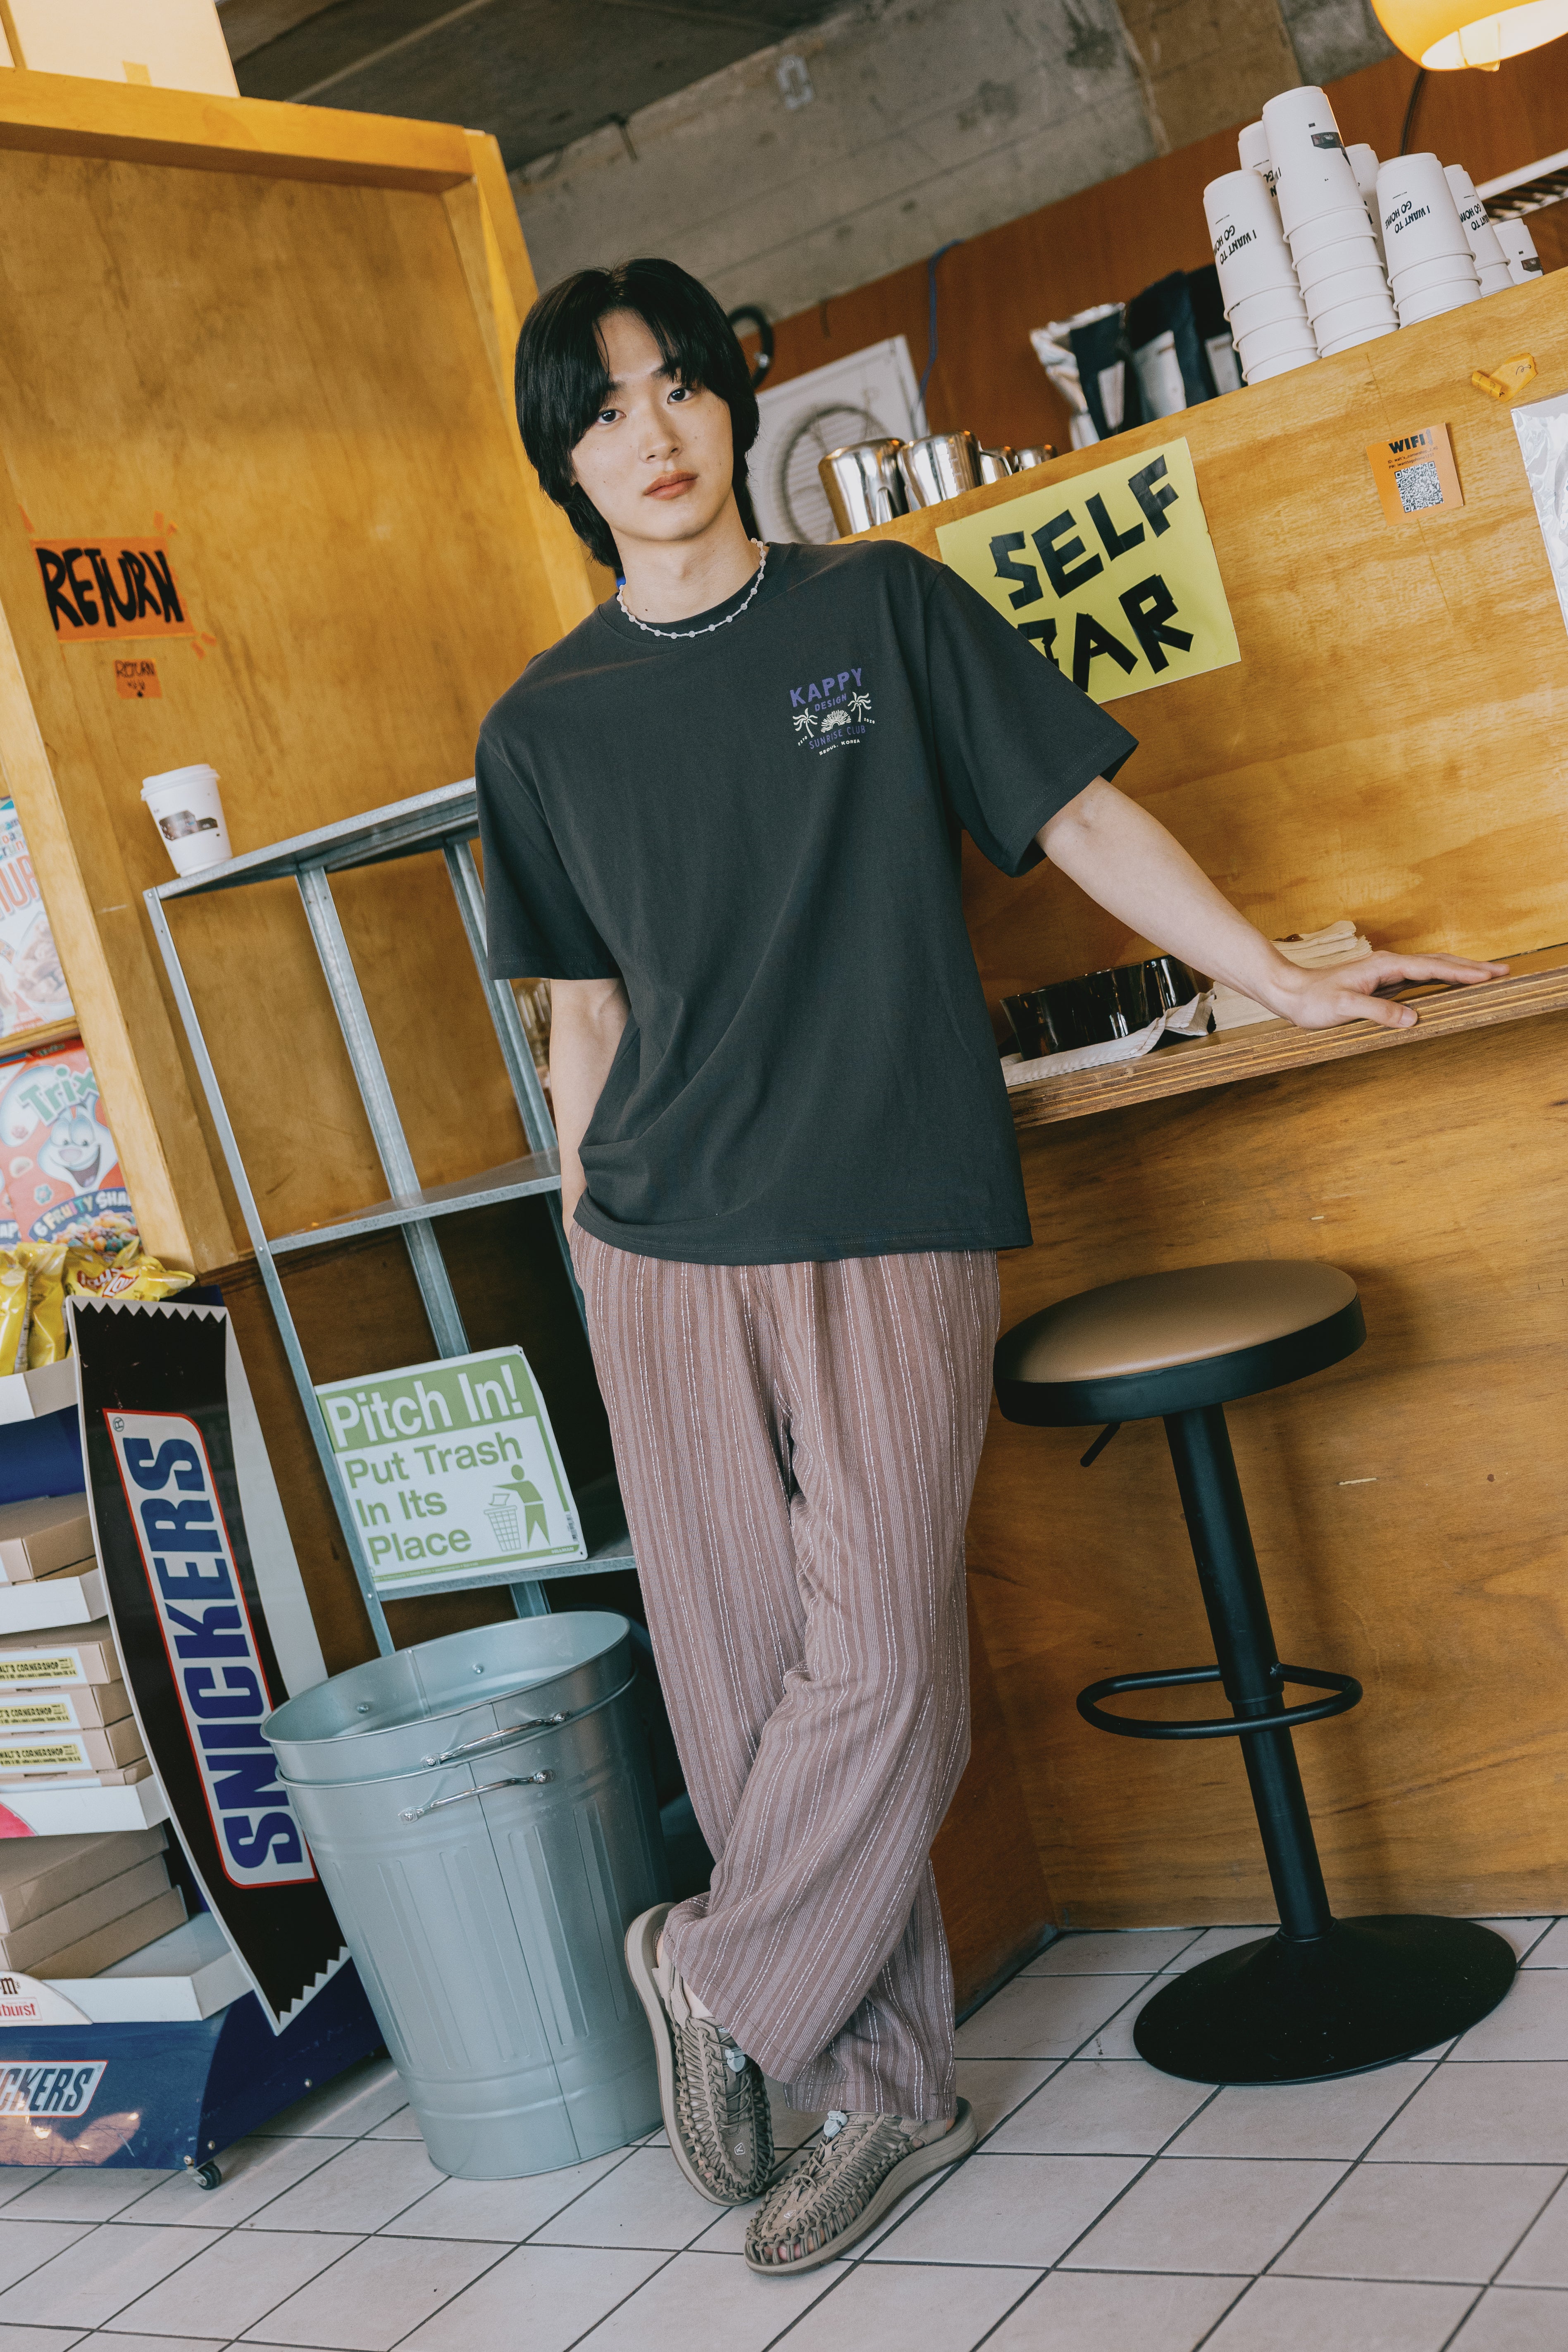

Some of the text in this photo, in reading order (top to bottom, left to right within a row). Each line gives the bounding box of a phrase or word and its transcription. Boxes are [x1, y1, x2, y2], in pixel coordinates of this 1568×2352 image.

[1385, 200, 1412, 230] GO HOME
[1395, 221, 1404, 234] TO
[1405, 207, 1426, 226] WANT
[1459, 203, 1481, 223] GO HOM
[1471, 220, 1481, 231] TO
[1224, 225, 1235, 241] GO
[1229, 232, 1252, 256] WANT
[1220, 250, 1228, 265] TO
[1389, 434, 1425, 454] WIFI
[989, 455, 1180, 610] SELF
[36, 547, 184, 631] RETURN
[789, 667, 862, 708] KAPPY
[814, 693, 847, 712] DESIGN
[809, 725, 866, 749] SUNRISE CLUB
[19, 1065, 99, 1124] Trix
[42, 1195, 94, 1230] FRUITY
[325, 1364, 524, 1447] Pitch In!
[344, 1432, 523, 1489] Put Trash
[355, 1489, 448, 1528] In Its
[366, 1528, 472, 1566] Place
[123, 1437, 303, 1868] SNICKERS
[0, 2003, 36, 2016] burst
[0, 2068, 95, 2112] CKERS
